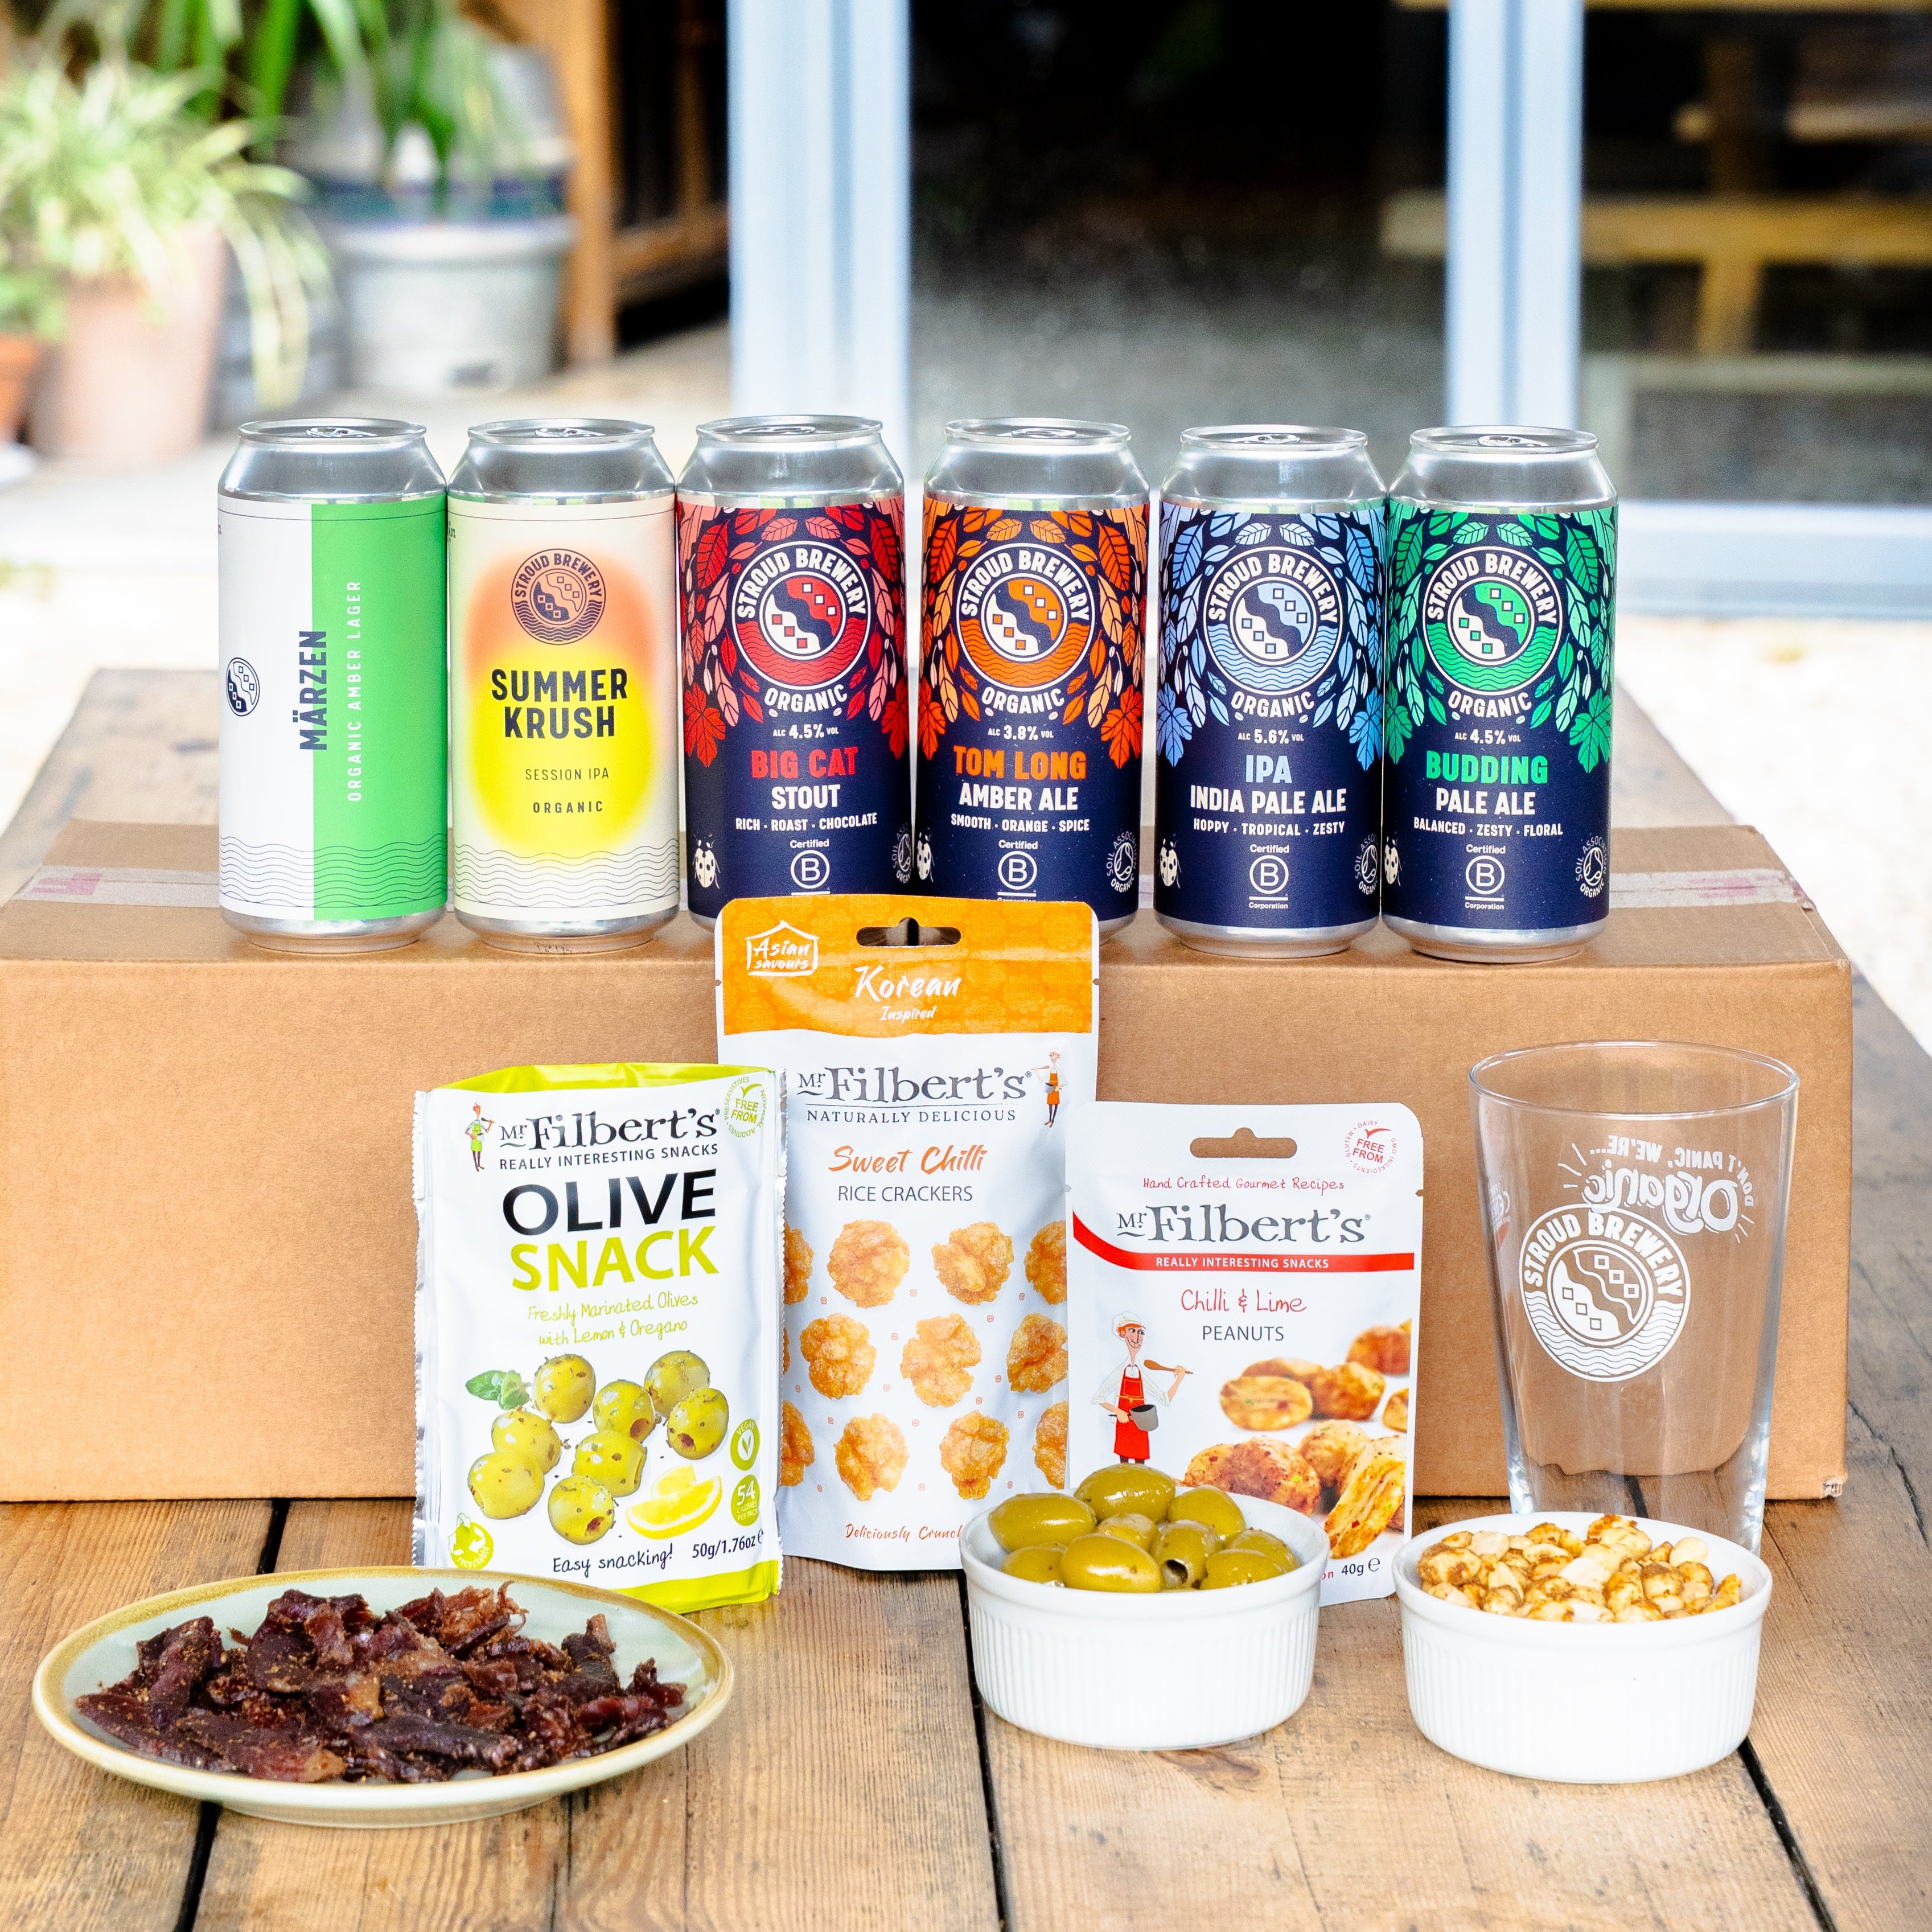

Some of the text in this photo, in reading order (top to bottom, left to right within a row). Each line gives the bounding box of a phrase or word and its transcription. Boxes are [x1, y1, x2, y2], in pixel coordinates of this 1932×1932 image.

[515, 553, 602, 598] STROUD BREWERY
[737, 548, 866, 619] STROUD BREWERY
[961, 550, 1090, 621] STROUD BREWERY
[1208, 553, 1337, 623] STROUD BREWERY
[1428, 553, 1557, 624] STROUD BREWERY
[293, 631, 327, 750] MÄRZEN
[347, 582, 361, 801] ORGANIC AMBER LAGER
[492, 668, 627, 702] SUMMER
[764, 684, 848, 713] ORGANIC
[981, 686, 1064, 714] ORGANIC
[1231, 691, 1314, 718] ORGANIC
[1448, 690, 1532, 718] ORGANIC
[505, 705, 615, 739] KRUSH
[788, 724, 824, 739] 4.5%
[1004, 725, 1038, 740] 3.8%
[1254, 729, 1289, 744] 5.6%
[1470, 729, 1506, 745] 4.5%
[525, 767, 609, 780] SESSION IPA
[751, 746, 858, 779] BIG CAT
[953, 745, 1087, 780] TOM LONG
[1245, 754, 1292, 784] IPA
[1426, 750, 1548, 784] BUDDING
[533, 801, 603, 813] ORGANIC
[771, 784, 841, 810] STOUT
[959, 783, 1078, 811] AMBER ALE
[1190, 785, 1347, 815] INDIA PALE ALE
[1436, 787, 1536, 815] PALE ALE
[735, 812, 877, 831] RICH ROAST CHOCOLATE
[951, 813, 1090, 832] SMOOTH ORANGE SPICE
[1194, 818, 1345, 836] HOPPY TROPICAL ZESTY
[1414, 816, 1563, 836] BALANCED ZESTY FLORAL
[790, 838, 829, 849] Certified
[998, 840, 1038, 850] Certified
[1249, 844, 1289, 854] Certified
[1466, 844, 1506, 854] Certified
[1106, 852, 1115, 877] SOIL
[1575, 857, 1584, 881] SOIL
[1111, 873, 1134, 893] ORGANIC
[1580, 878, 1604, 898] ORGANIC
[1248, 902, 1288, 911] Corporation
[1465, 902, 1505, 911] Corporation
[754, 938, 811, 957] Asian
[755, 959, 808, 970] savours
[854, 965, 962, 1002] Korean
[879, 1005, 937, 1024] Inspired
[724, 1076, 749, 1120] PRESERVATIVES
[735, 1098, 759, 1112] FREE
[731, 1109, 757, 1124] FROM
[807, 1109, 1016, 1123] NATURALLY DELICIOUS
[729, 1124, 755, 1138] ADDITIVES
[1345, 1131, 1354, 1157] GLUTEN
[1353, 1148, 1383, 1164] FROM
[1356, 1138, 1385, 1153] FREE
[500, 1143, 718, 1170] REALLY INTERESTING SNACKS
[828, 1145, 988, 1174] Sweet Chilli
[838, 1186, 973, 1202] RICE CRACKERS
[1143, 1175, 1345, 1196] Hand Crafted Gourmet Recipes
[503, 1168, 717, 1236] OLIVE
[511, 1225, 719, 1292] SNACK
[1156, 1257, 1329, 1269] REALLY INTERESTING SNACKS
[1524, 1210, 1683, 1297] STROUD BREWERY
[528, 1290, 698, 1327] Freshly Marinated Olives
[1181, 1288, 1307, 1313] Chilli & Lime
[539, 1319, 687, 1345] with Lemon & Oregano
[1203, 1326, 1284, 1341] PEANUTS
[737, 1420, 755, 1435] VEGAN
[737, 1481, 756, 1506] 54
[845, 1523, 910, 1542] Deliciously
[553, 1557, 591, 1578] Easy
[598, 1543, 673, 1569] snacking!
[692, 1535, 756, 1560] 50g/1.76oz
[1341, 1563, 1364, 1576] 40g
